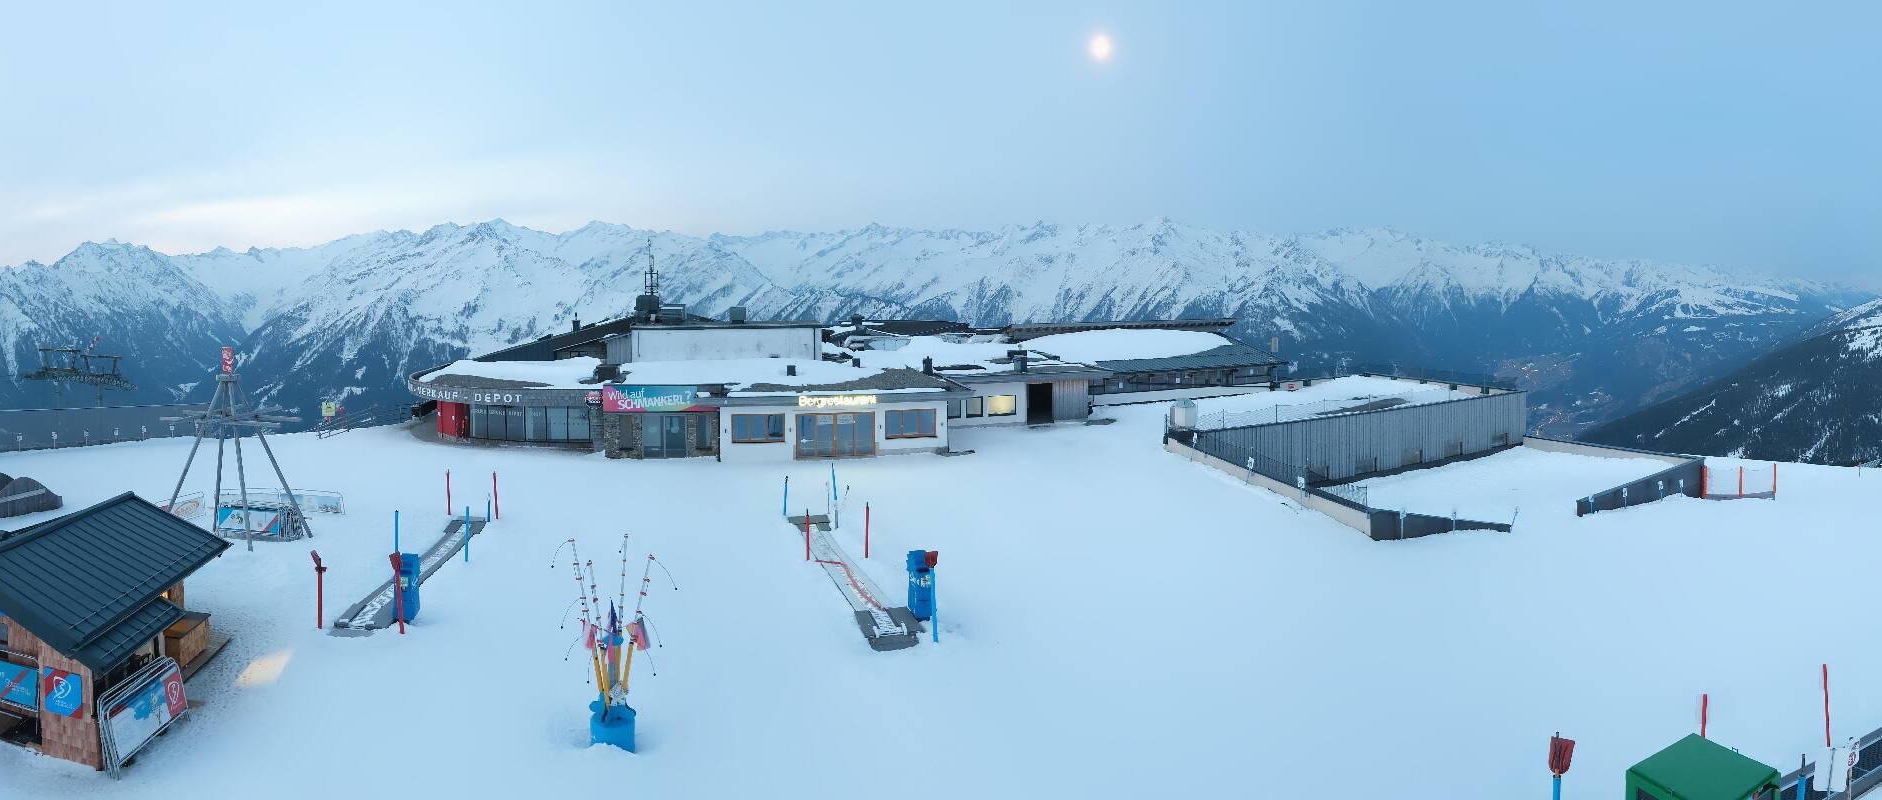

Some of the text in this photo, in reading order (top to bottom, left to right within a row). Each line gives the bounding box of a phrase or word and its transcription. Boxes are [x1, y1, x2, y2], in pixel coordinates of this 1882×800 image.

[418, 386, 458, 400] VERKAUF
[474, 393, 522, 403] DEPOT
[607, 387, 645, 401] Wild auf
